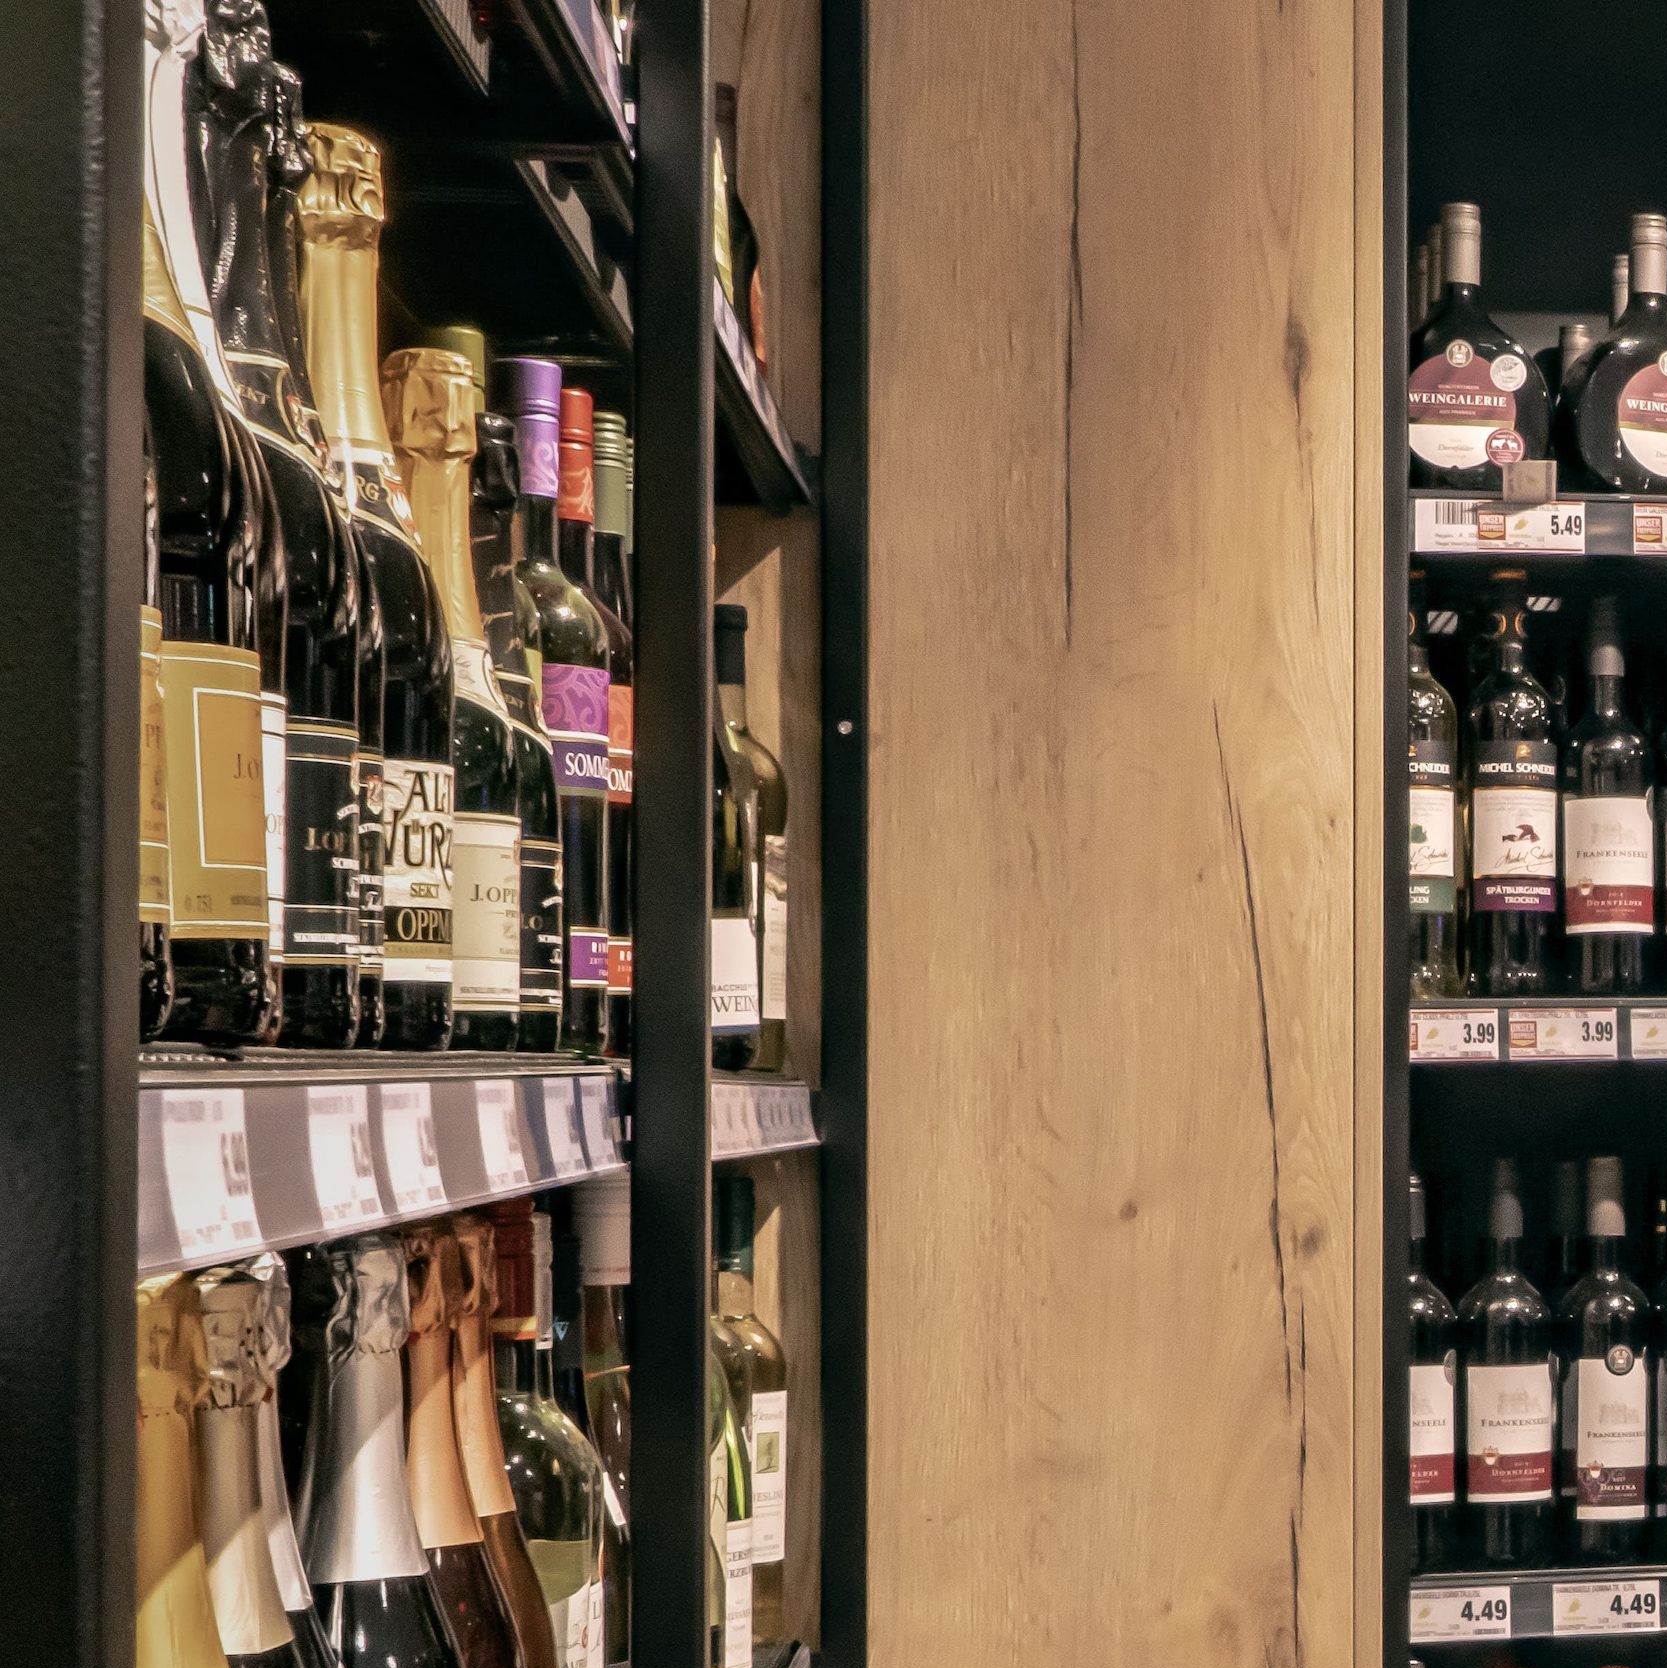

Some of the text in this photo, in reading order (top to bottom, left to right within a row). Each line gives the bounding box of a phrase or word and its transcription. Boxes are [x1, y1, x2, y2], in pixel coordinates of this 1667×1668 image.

[1409, 392, 1507, 408] WEINGALERIE
[1550, 513, 1583, 536] 5.49
[1479, 762, 1513, 774] MICHEL
[410, 884, 438, 897] SEKT
[1586, 899, 1642, 908] DORNFELDER
[1463, 1023, 1495, 1044] 3.99
[1581, 1021, 1613, 1042] 3.99
[1600, 1483, 1636, 1491] DOMINA
[1461, 1599, 1508, 1621] 4.49
[1610, 1593, 1657, 1615] 4.49
